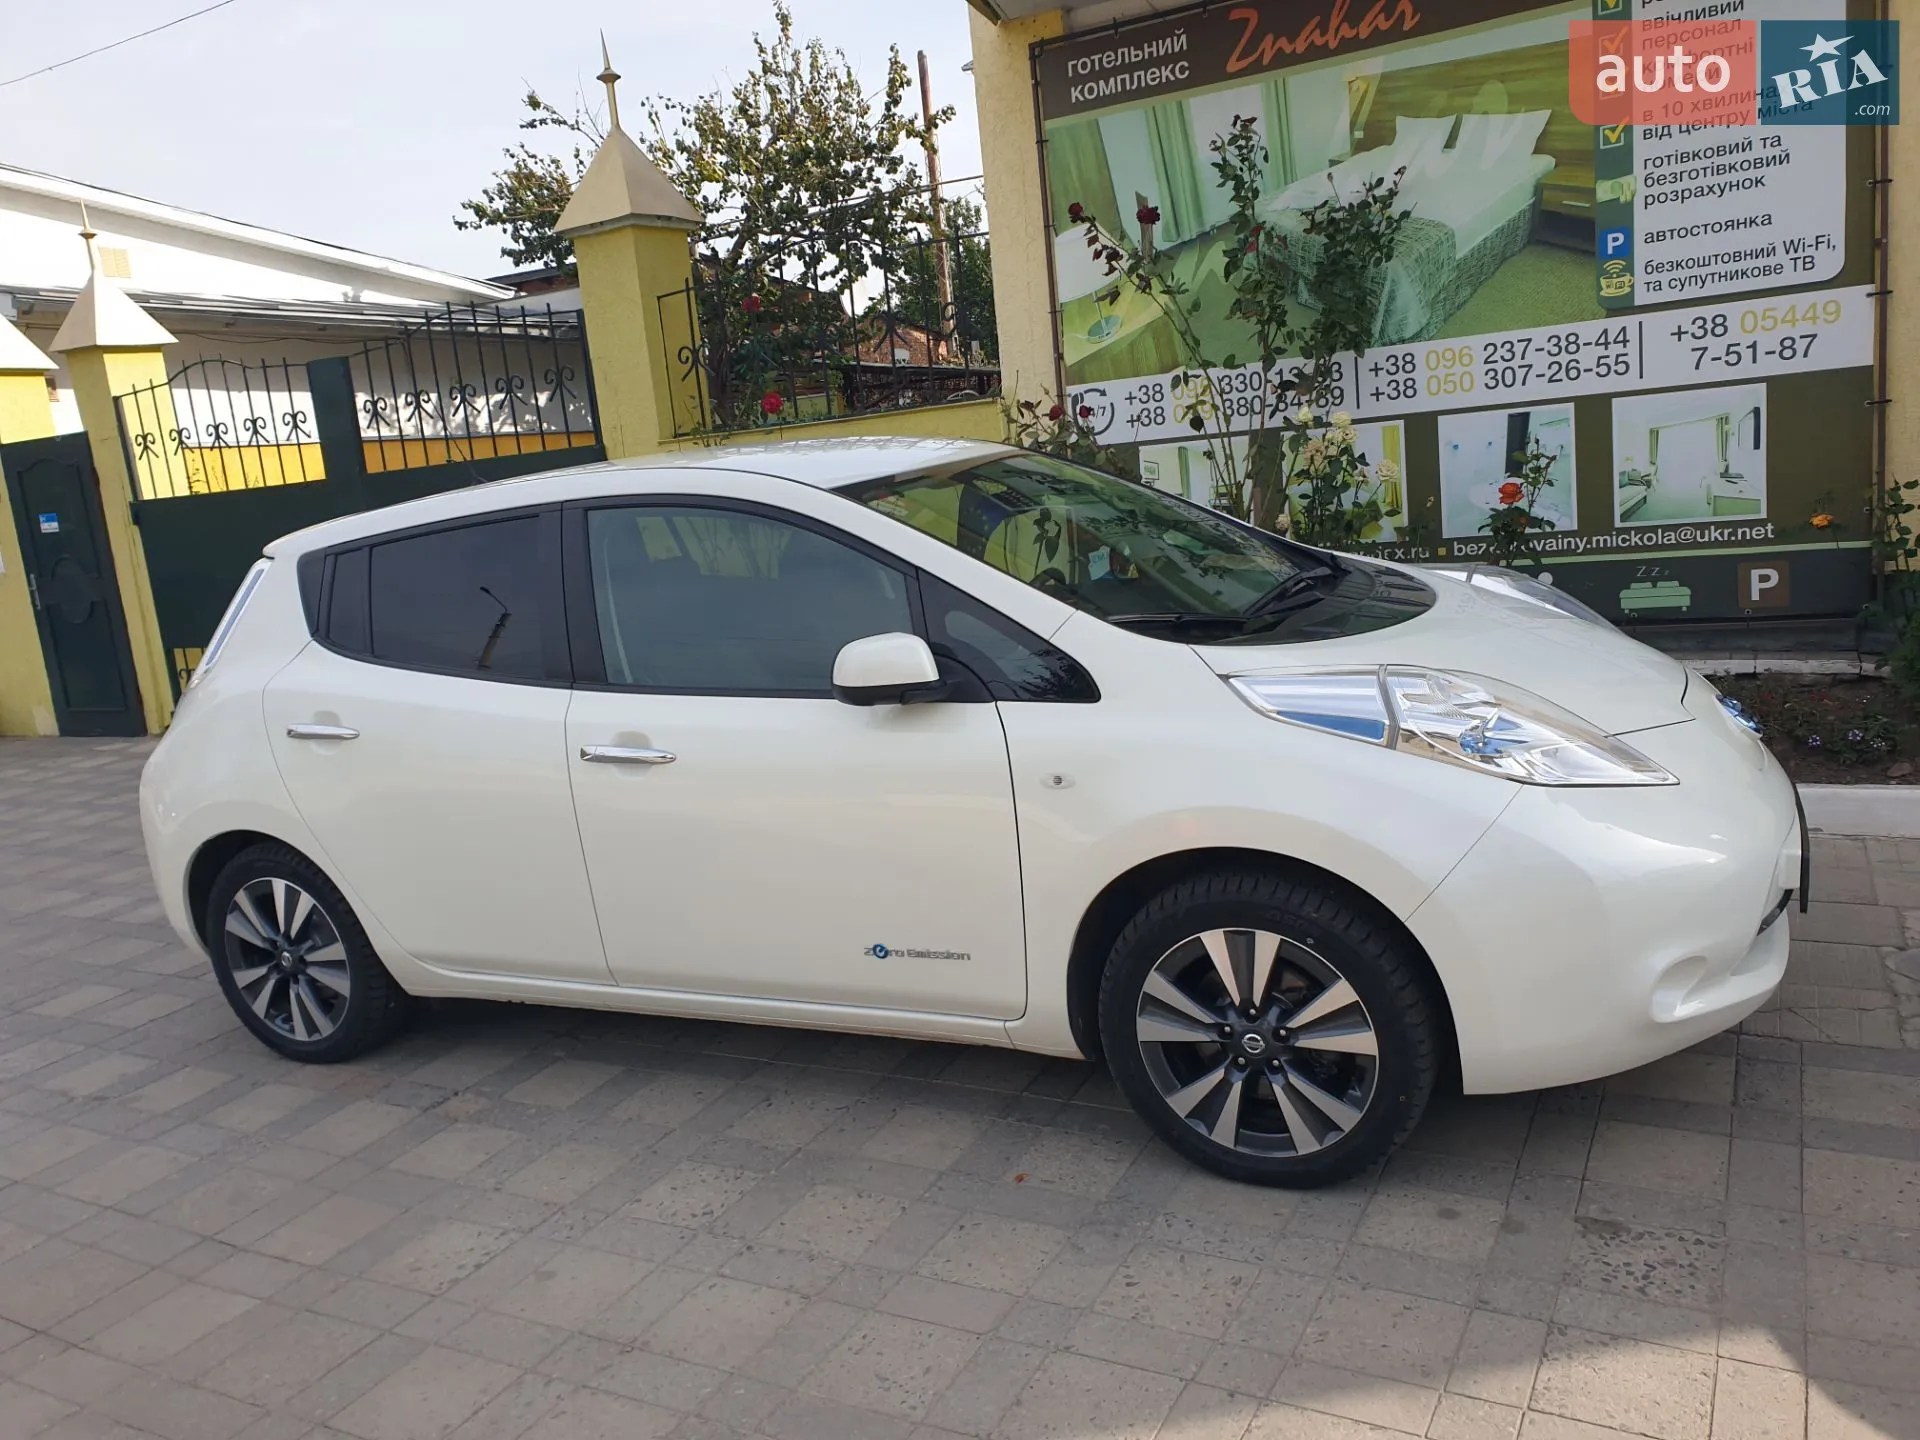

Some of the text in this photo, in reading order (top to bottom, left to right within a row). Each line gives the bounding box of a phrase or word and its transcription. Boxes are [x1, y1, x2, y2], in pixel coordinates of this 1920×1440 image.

[1067, 27, 1188, 78] готельний
[1642, 19, 1742, 51] персонал
[1070, 60, 1190, 104] комплекс
[1643, 83, 1789, 122] в 10 хвилина
[1643, 124, 1673, 141] від
[1678, 108, 1751, 136] центру
[1644, 135, 1782, 170] готівковий та
[1644, 149, 1790, 188] безготівковий
[1644, 175, 1766, 209] розрахунок
[1607, 232, 1625, 255] P
[1644, 213, 1773, 244] автостоянка
[1644, 234, 1836, 275] безкоштовний Wi-Fi,
[1644, 255, 1816, 293] та супутникове ТВ
[1670, 299, 1841, 342] +38 05449
[1369, 325, 1630, 378] +38 096 237-38-44
[1691, 333, 1818, 370] 7-51-87
[1125, 383, 1165, 405] +38
[1370, 352, 1630, 402] +38 050 307-26-55
[1126, 405, 1166, 428] +38
[1173, 400, 1214, 423] 09
[1750, 568, 1779, 601] P
[906, 948, 971, 961] Emission
